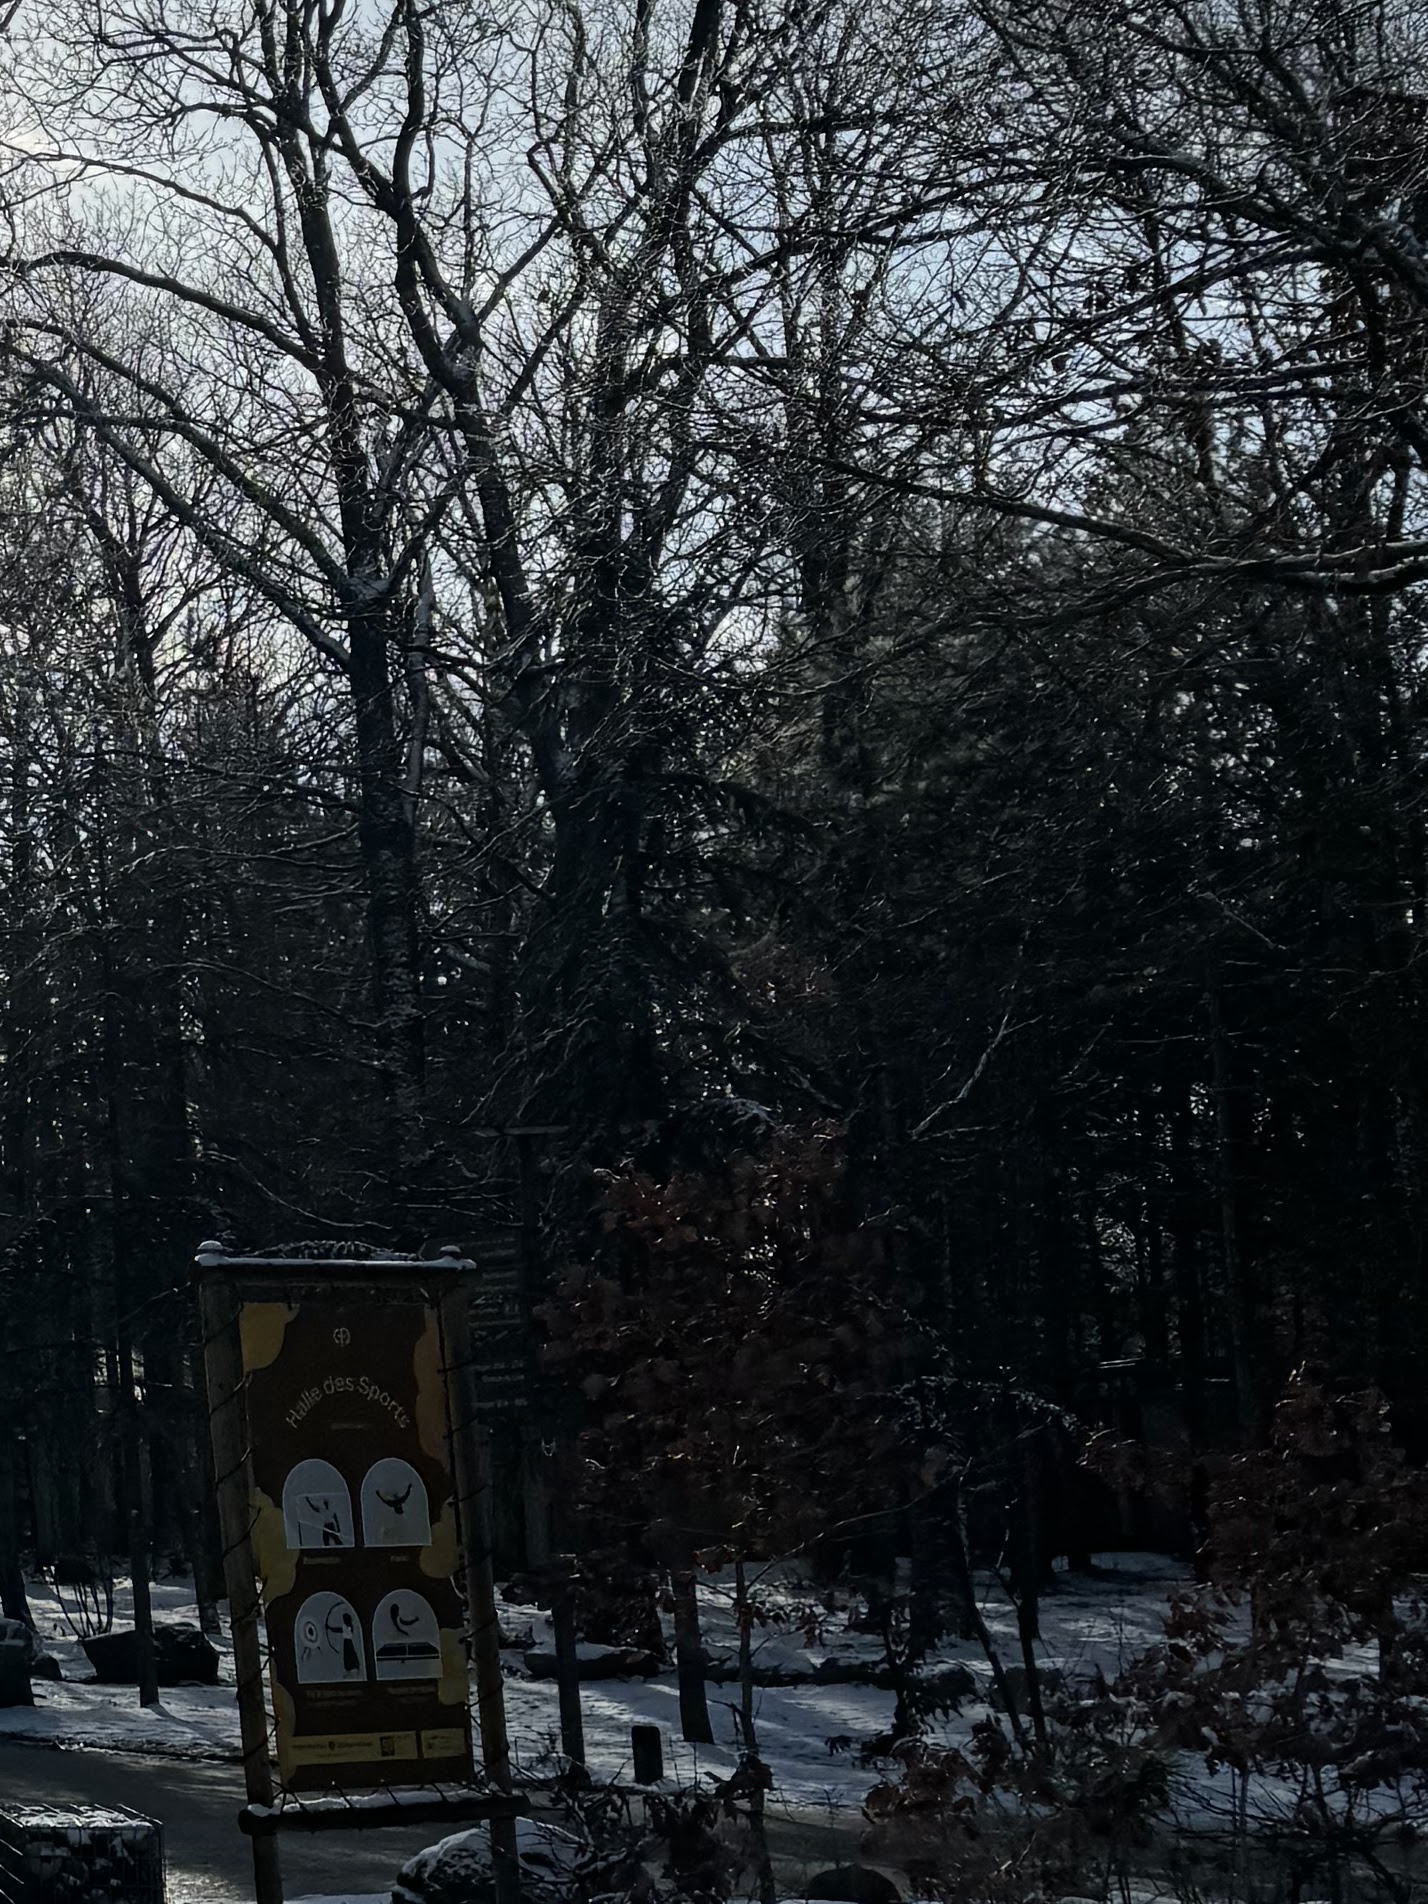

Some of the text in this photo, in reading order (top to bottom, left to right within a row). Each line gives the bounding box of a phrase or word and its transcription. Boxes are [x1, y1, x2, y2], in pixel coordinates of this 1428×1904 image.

[285, 1376, 410, 1428] Halle des Sports
